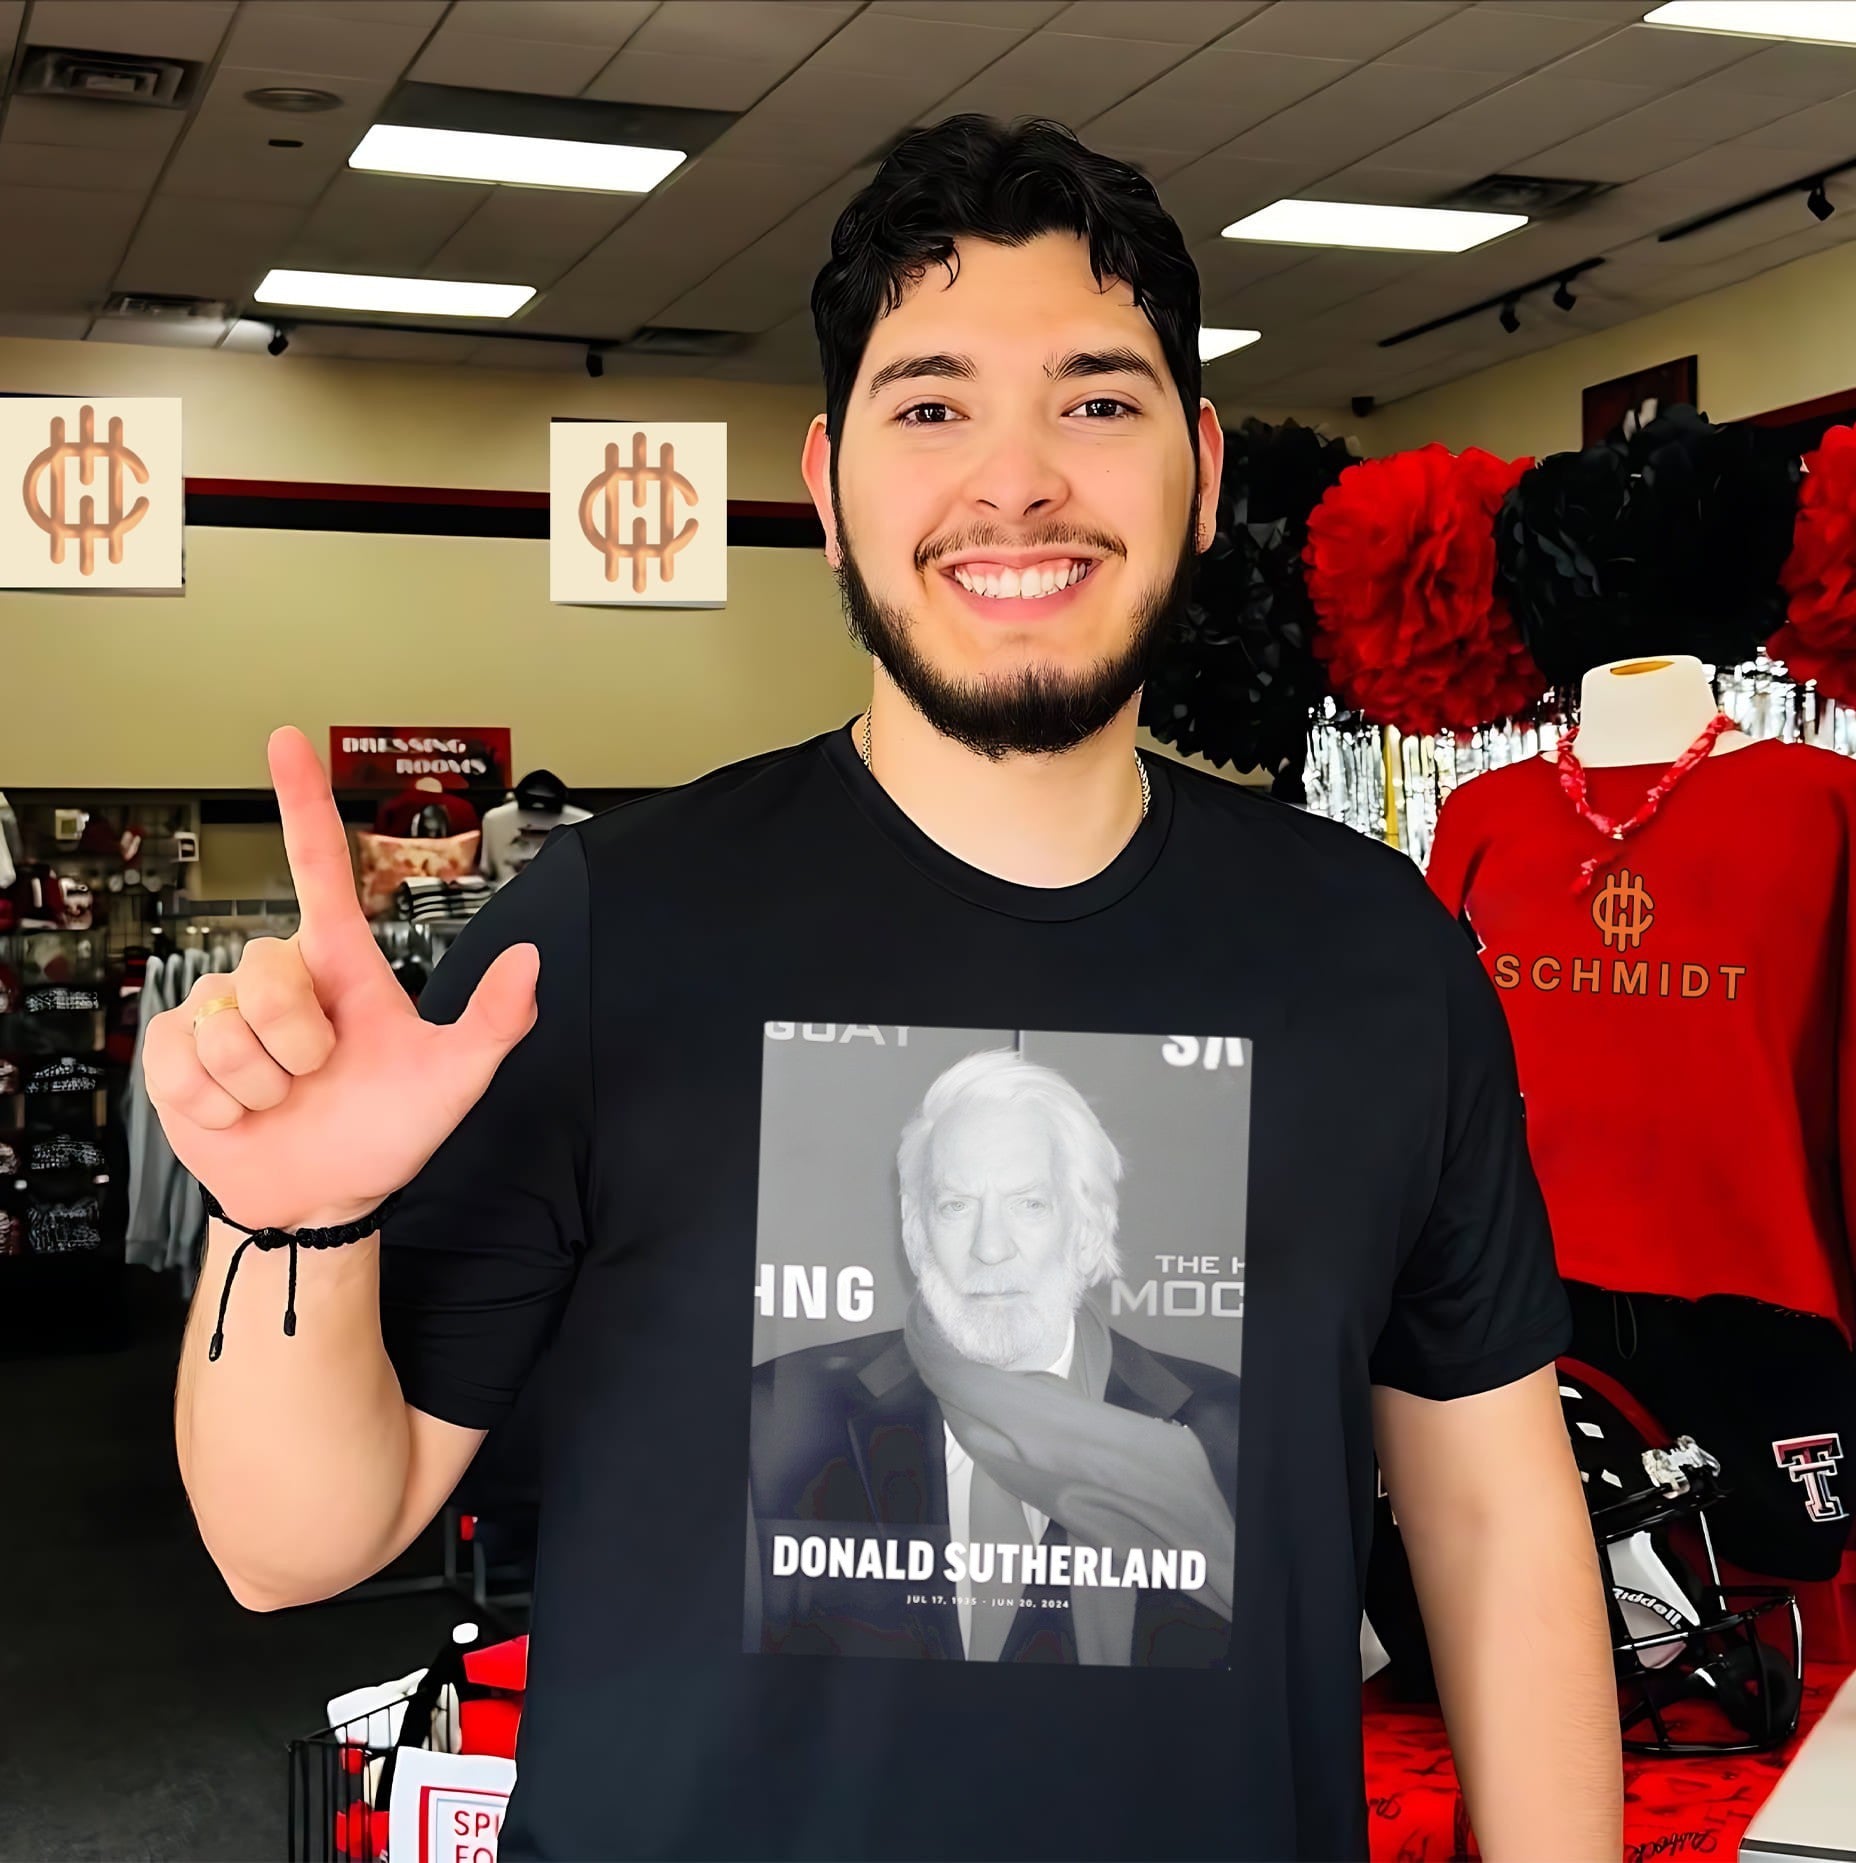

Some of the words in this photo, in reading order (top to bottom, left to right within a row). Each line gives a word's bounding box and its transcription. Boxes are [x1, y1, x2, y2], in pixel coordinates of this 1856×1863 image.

[1495, 954, 1746, 1000] SCHMIDT
[1155, 1255, 1220, 1274] THE
[1111, 1279, 1245, 1318] MOC
[773, 1535, 934, 1580] DONALD
[943, 1541, 1207, 1591] SUTHERLAND
[906, 1595, 927, 1605] JUL
[991, 1598, 1014, 1607] JUN
[1041, 1599, 1069, 1609] 2024
